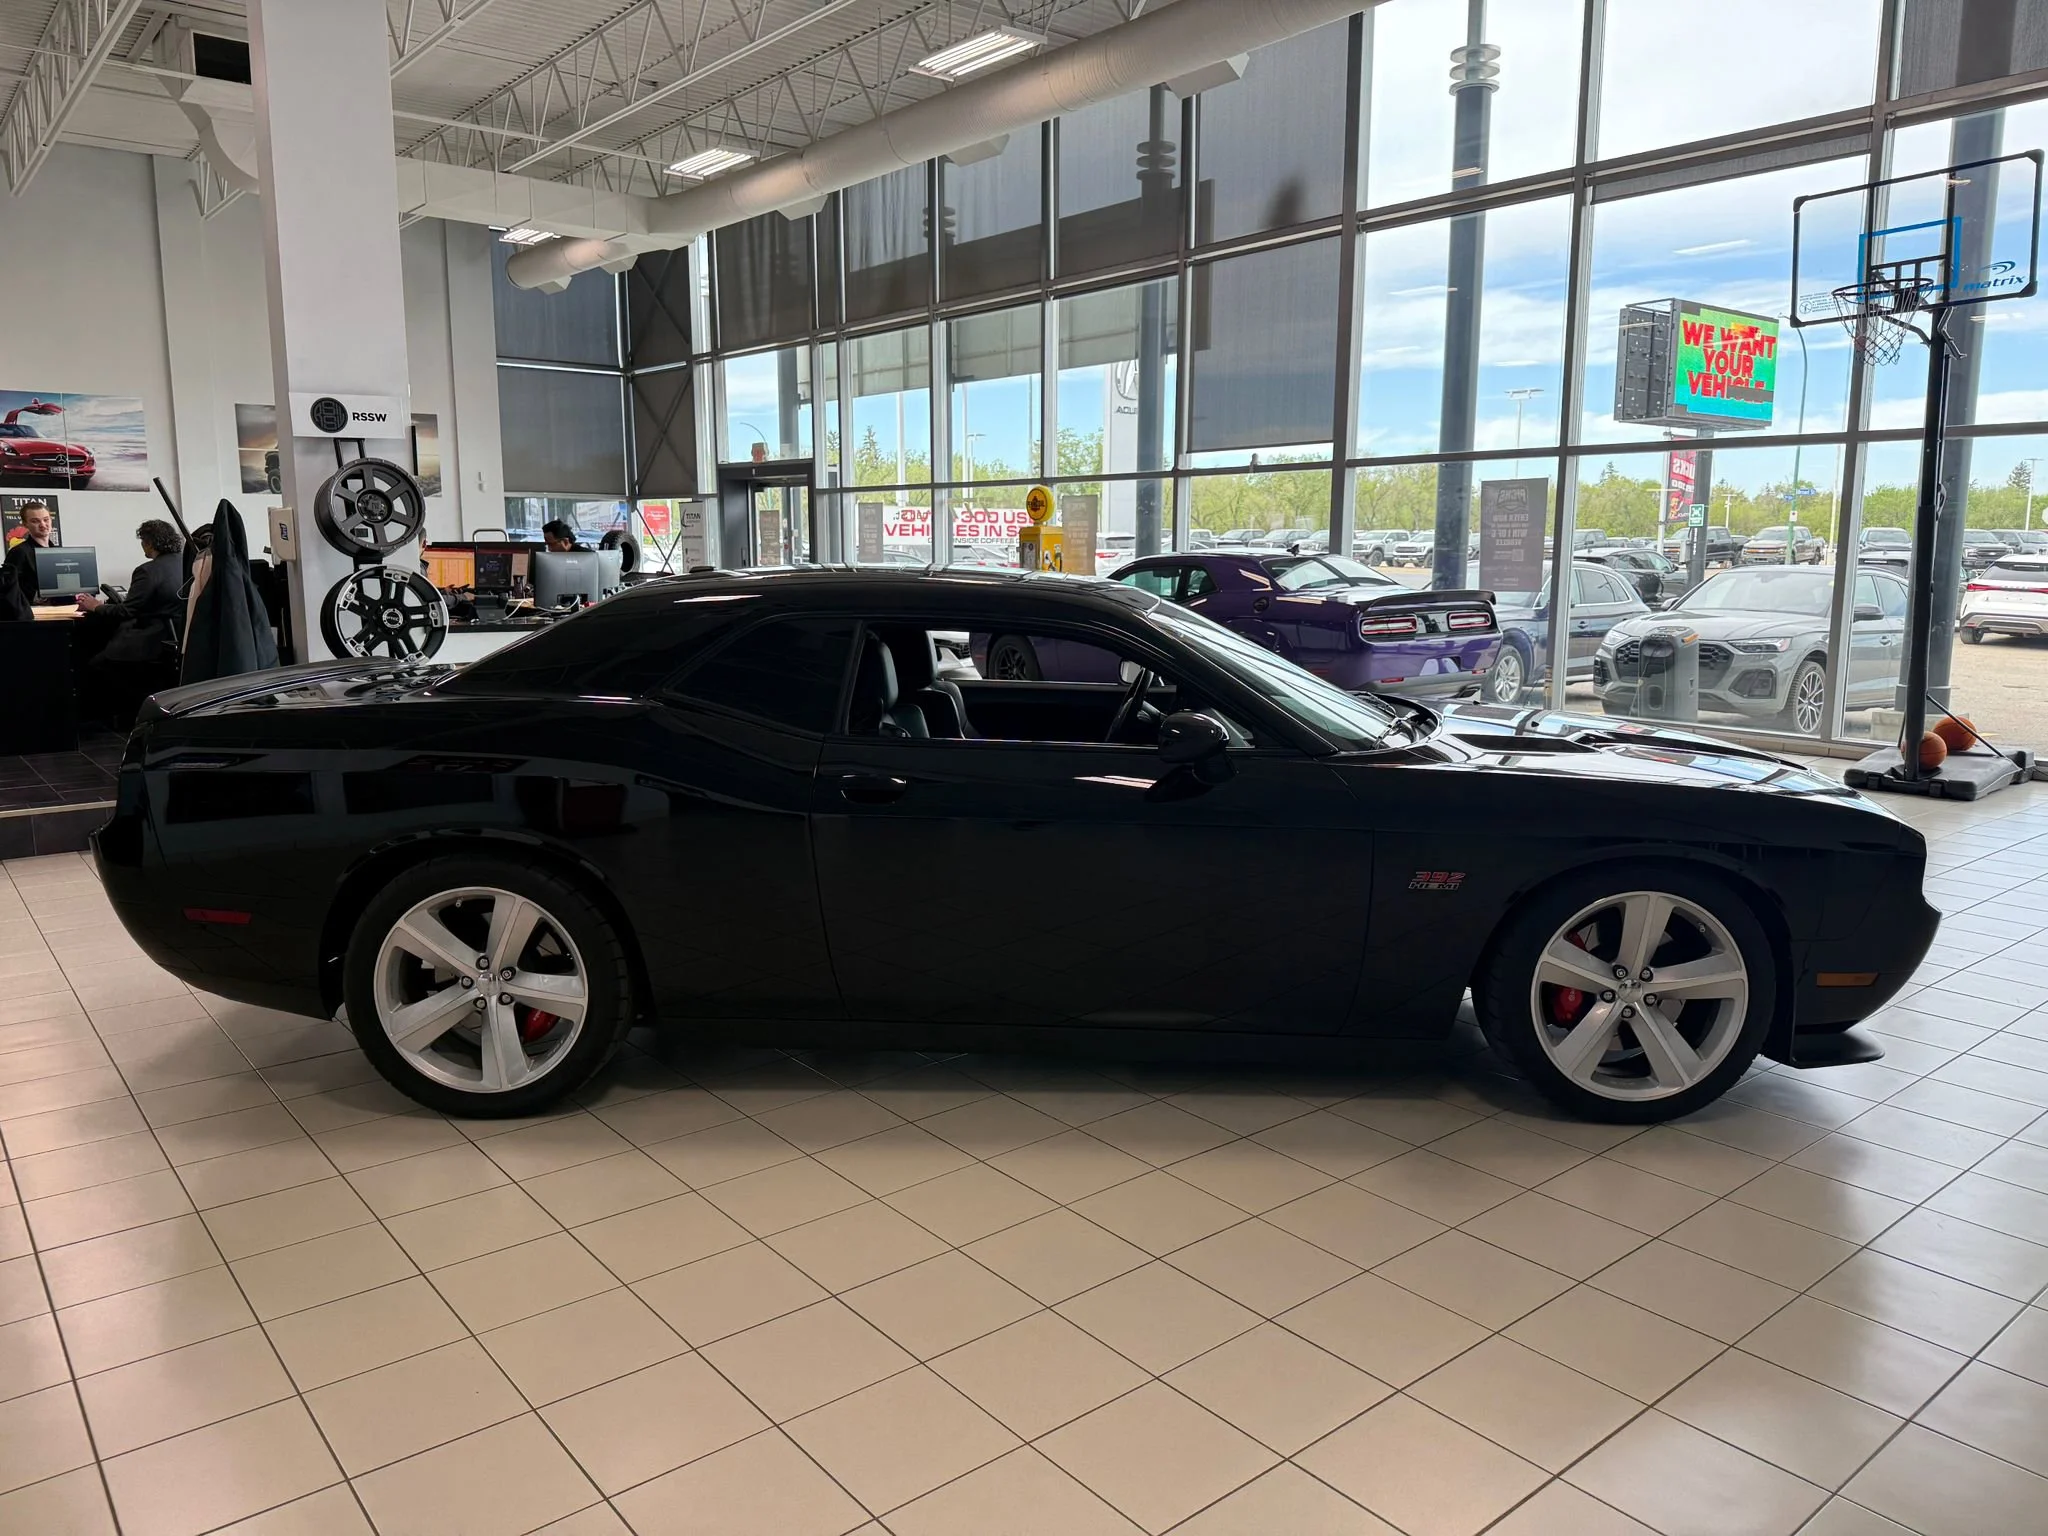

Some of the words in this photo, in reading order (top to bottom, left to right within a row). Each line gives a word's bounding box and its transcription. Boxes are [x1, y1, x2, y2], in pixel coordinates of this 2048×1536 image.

[1963, 275, 2026, 292] matrix
[1682, 320, 1715, 350] WE
[1720, 327, 1777, 359] WANT
[1703, 349, 1755, 379] YOUR
[1116, 405, 1138, 415] ACU
[352, 412, 387, 422] RSSW
[11, 497, 47, 506] TITAN
[961, 511, 999, 524] 300
[1003, 511, 1034, 524] US
[884, 523, 979, 538] VEHIES
[984, 525, 1002, 538] IN
[1411, 871, 1466, 883] 392
[1408, 881, 1460, 891] HEMI
